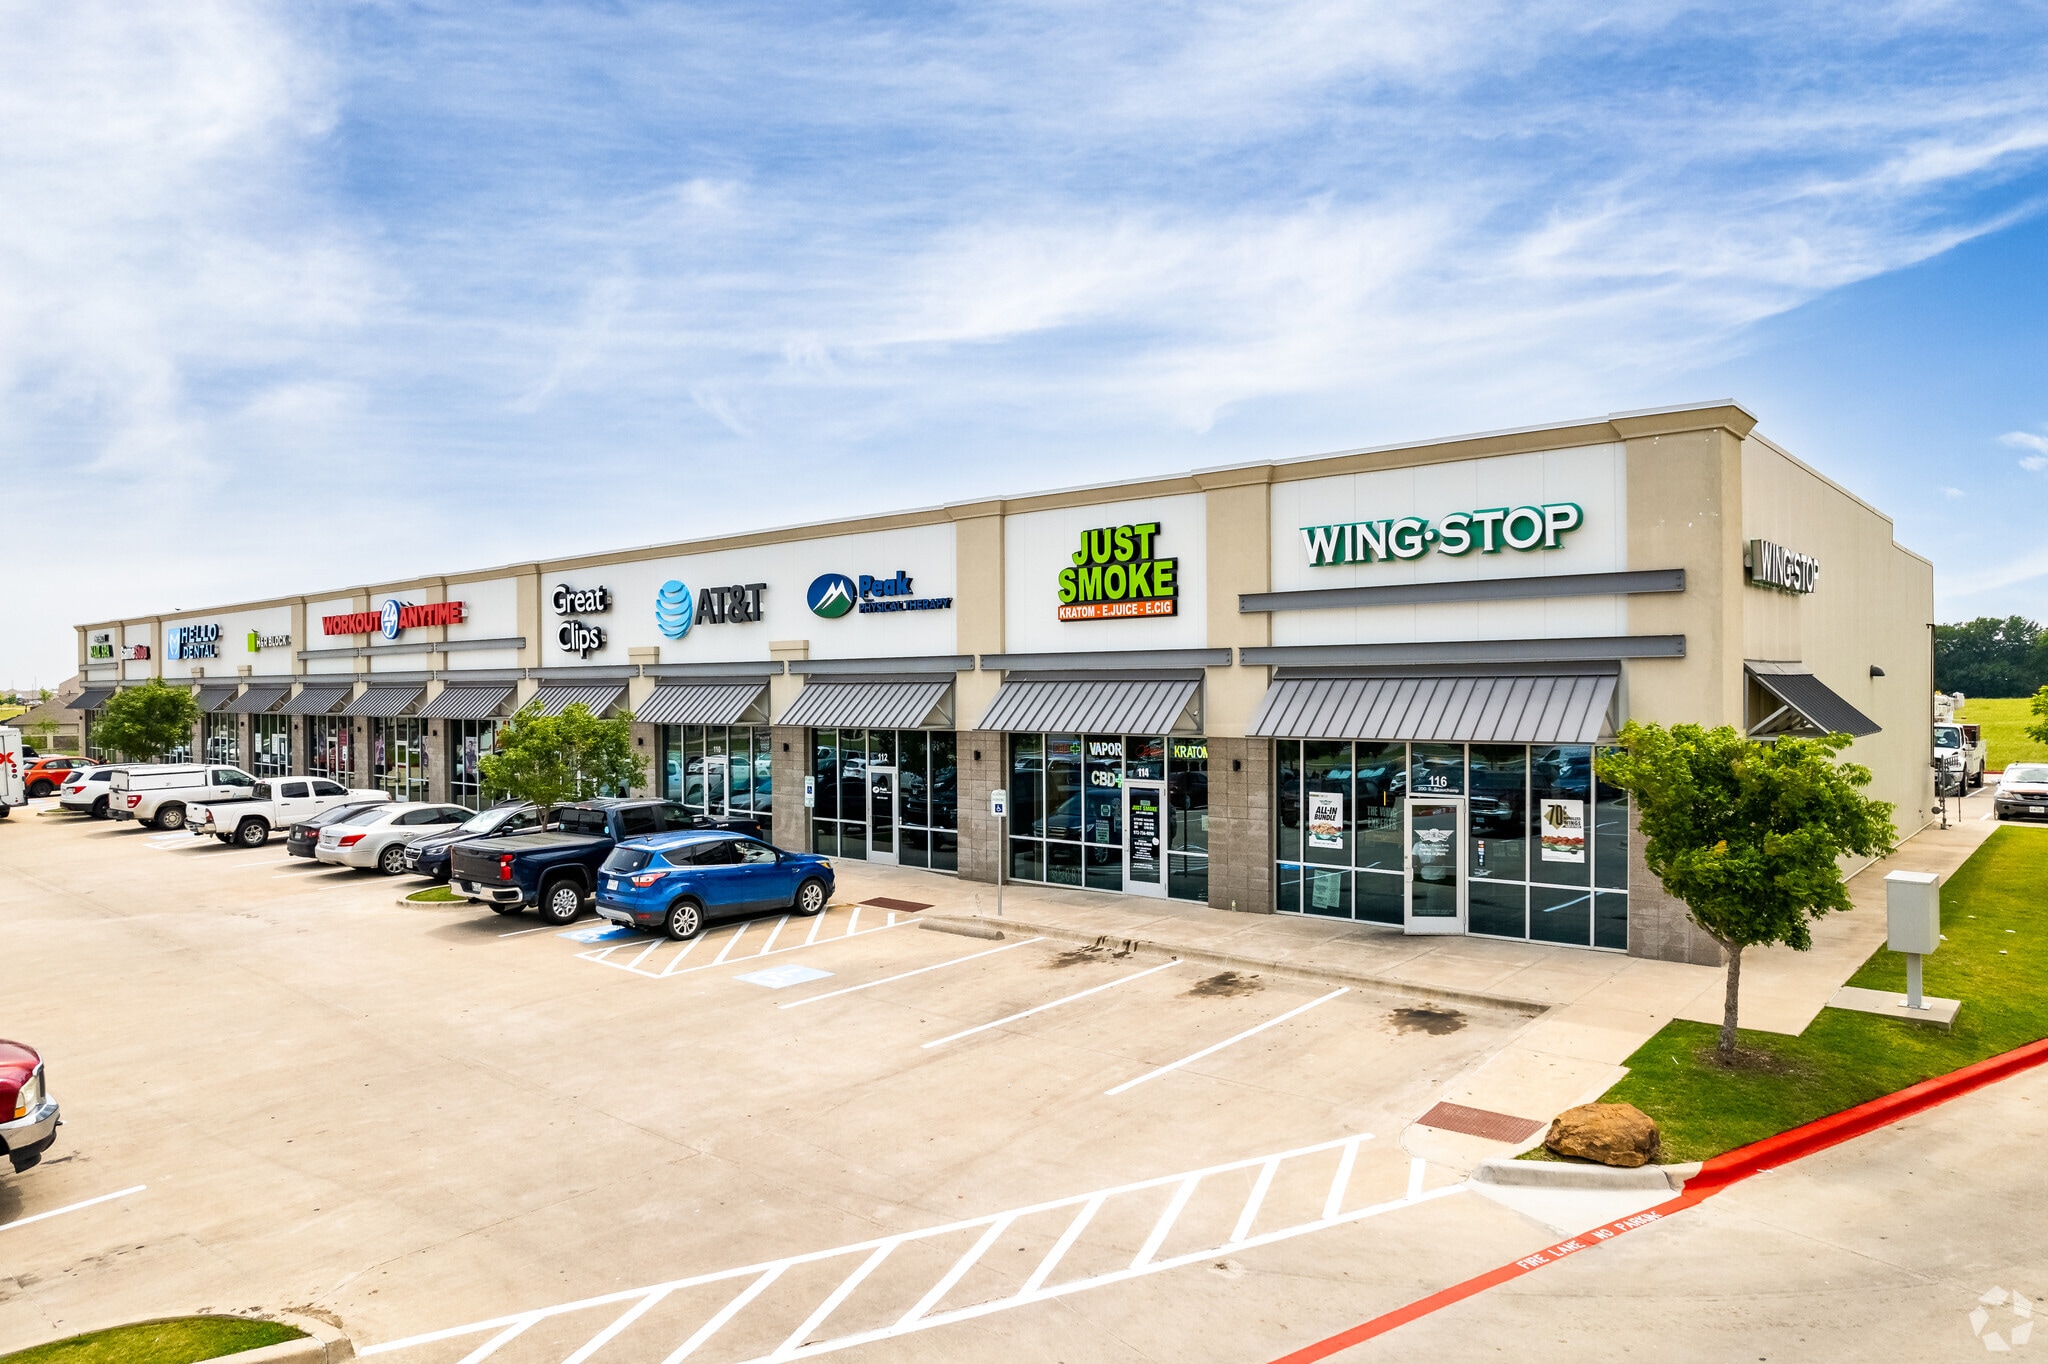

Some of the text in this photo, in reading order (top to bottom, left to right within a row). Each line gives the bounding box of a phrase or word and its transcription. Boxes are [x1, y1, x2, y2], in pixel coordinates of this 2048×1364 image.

[1072, 522, 1160, 566] JUST
[859, 571, 913, 598] Peak
[1058, 558, 1177, 603] SMOKE
[551, 584, 606, 616] Great
[694, 583, 766, 625] AT&T
[859, 598, 953, 614] PHYSICAL THERAPY
[398, 601, 463, 629] ANYTIME
[1059, 605, 1095, 619] KRATOM
[1102, 603, 1138, 616] E.JUICE
[1145, 601, 1171, 614] E.CIG
[322, 611, 381, 636] WORKOUT
[181, 624, 219, 643] HELLO
[268, 635, 287, 647] BLOCK
[557, 620, 602, 658] Clips
[183, 645, 216, 659] DENTAL
[878, 753, 888, 762] 112
[1089, 742, 1122, 757] VAPOR
[1138, 768, 1149, 777] 114
[1429, 776, 1448, 787] 116
[1316, 806, 1338, 815] ALL-IN
[1516, 1254, 1550, 1270] FIRE
[1547, 1240, 1586, 1257] LANE
[1591, 1228, 1614, 1239] NO
